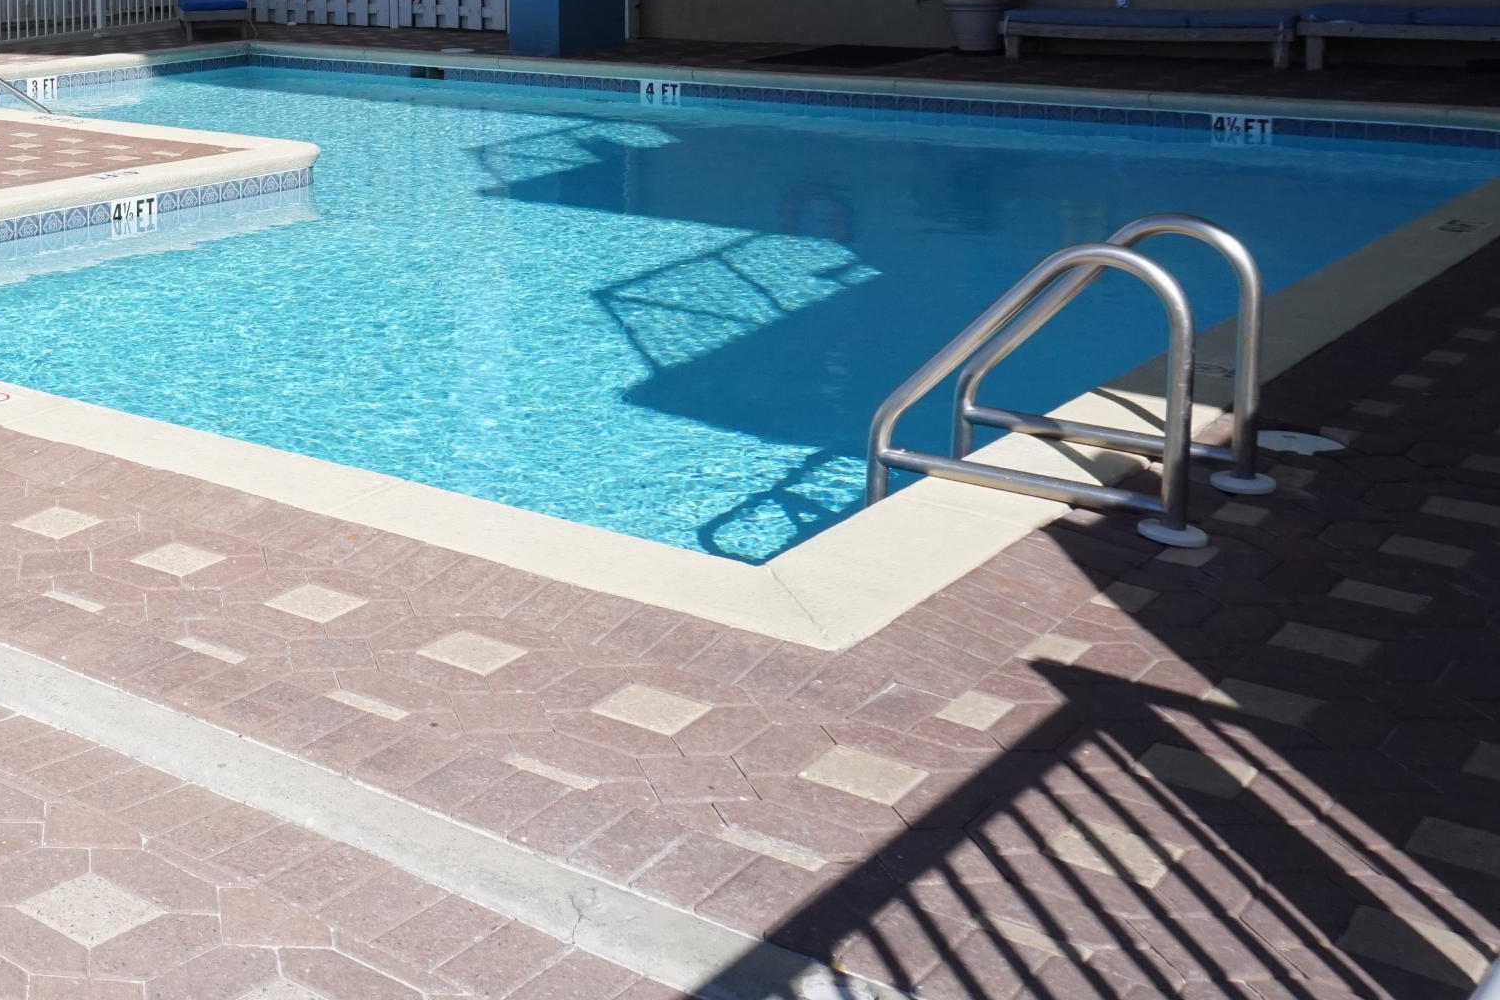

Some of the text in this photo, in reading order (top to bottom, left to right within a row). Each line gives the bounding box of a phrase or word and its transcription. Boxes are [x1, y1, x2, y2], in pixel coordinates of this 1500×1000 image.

[645, 82, 679, 96] 4 FT
[1243, 118, 1269, 134] FT
[136, 197, 155, 218] FT
